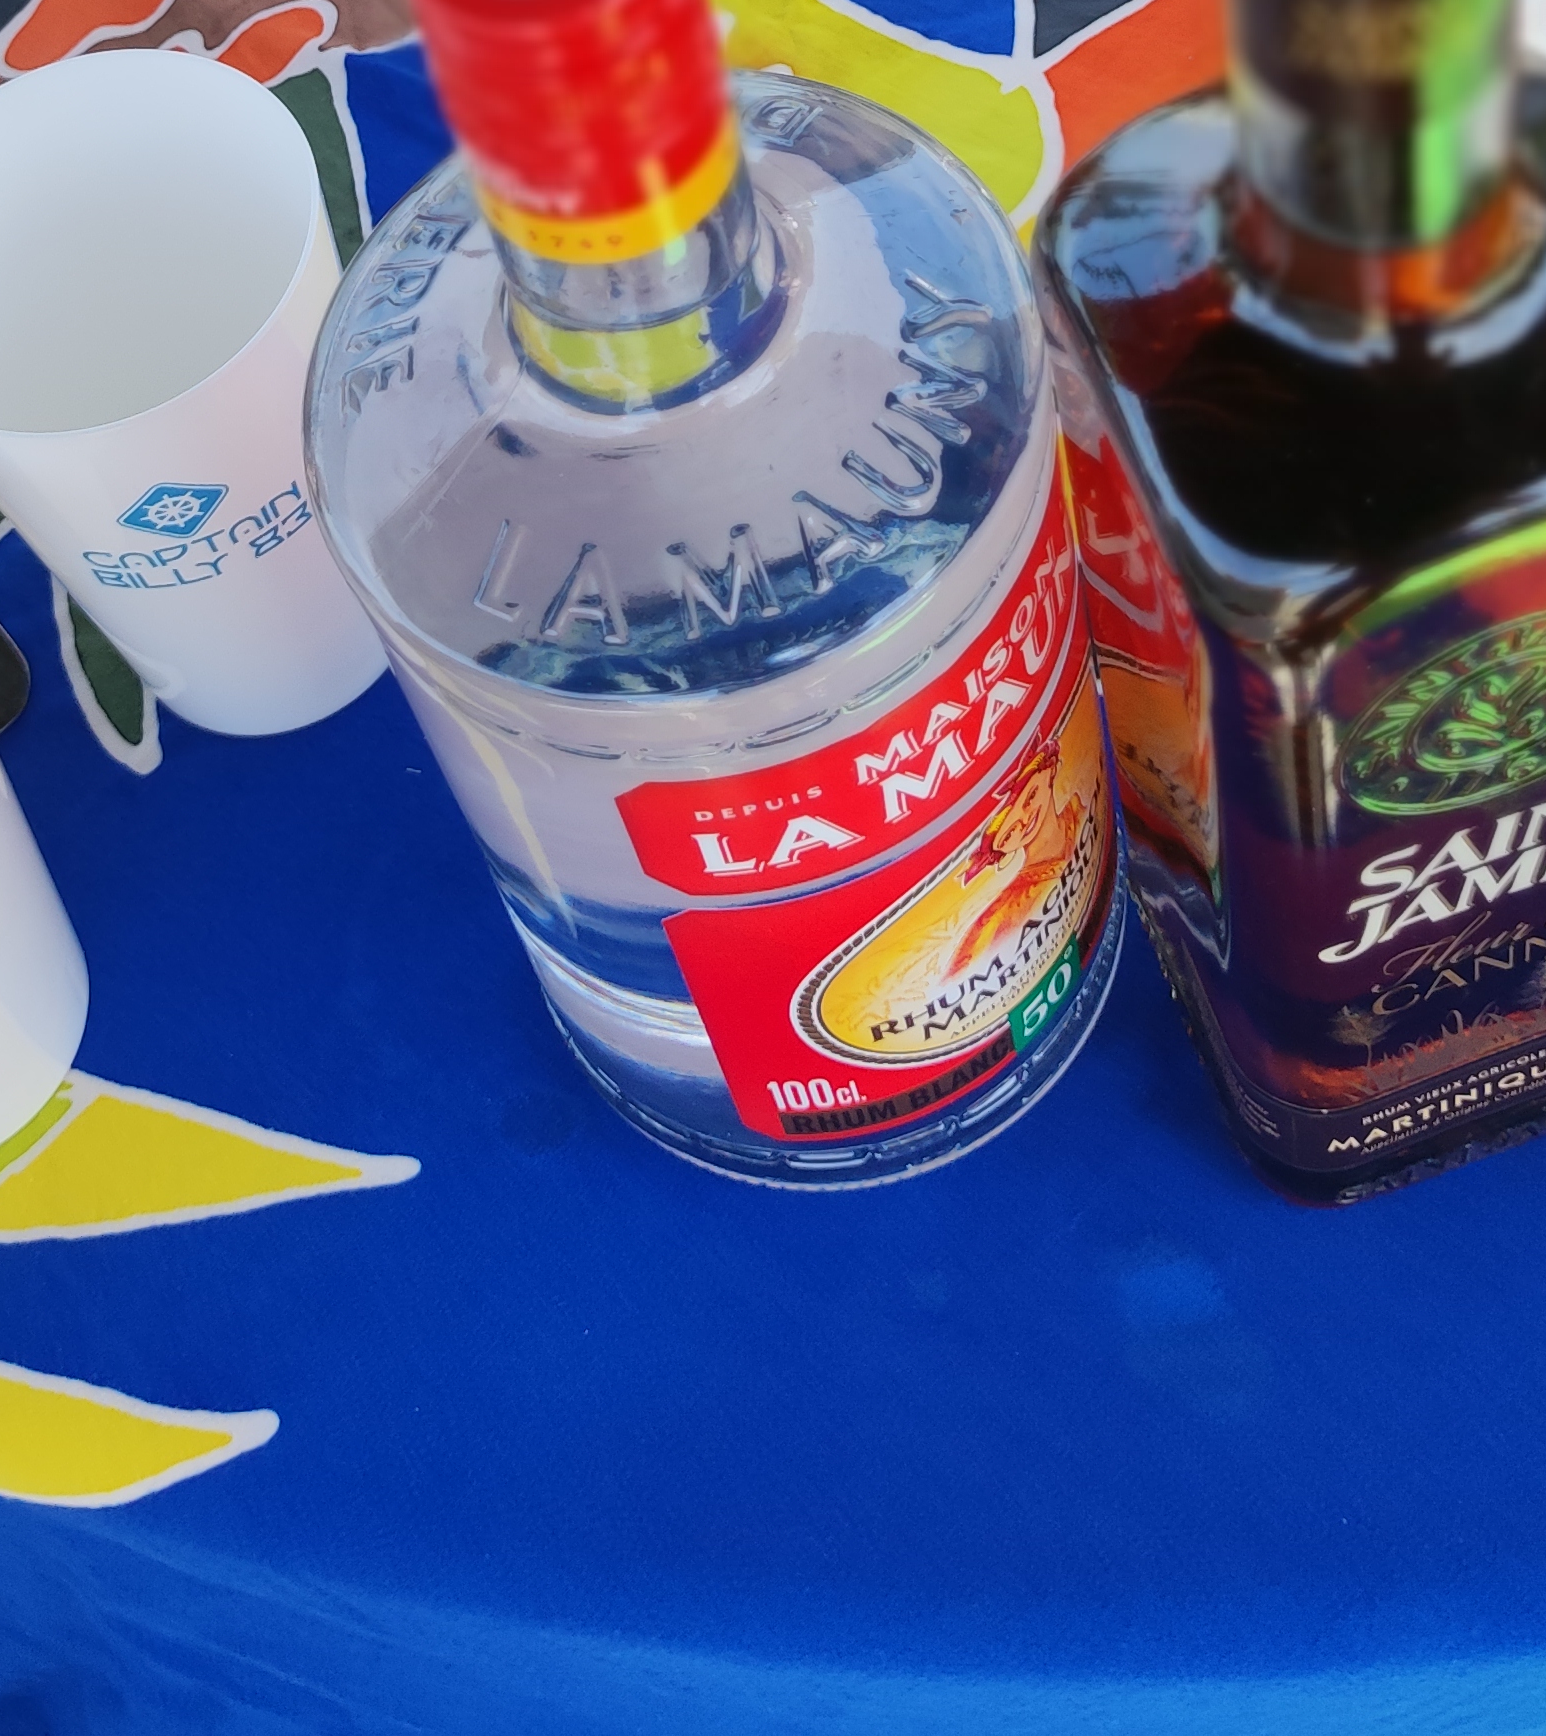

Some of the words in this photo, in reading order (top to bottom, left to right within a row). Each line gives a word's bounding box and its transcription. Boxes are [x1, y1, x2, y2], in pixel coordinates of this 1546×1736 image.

[473, 518, 629, 645] LA
[665, 268, 994, 642] MAUNY
[82, 479, 303, 570] CAPTAIN
[90, 553, 229, 590] BILLY
[853, 534, 1057, 786] MAISON
[691, 813, 866, 877] LA
[694, 785, 824, 823] DEPUIS
[1371, 910, 1535, 994] Fleur
[870, 953, 1005, 1043] RHUM
[793, 1103, 900, 1135] RHUM
[905, 1031, 1016, 1110] BLANC
[1361, 1099, 1412, 1127] RHUM
[1415, 1079, 1463, 1105] VIEUX
